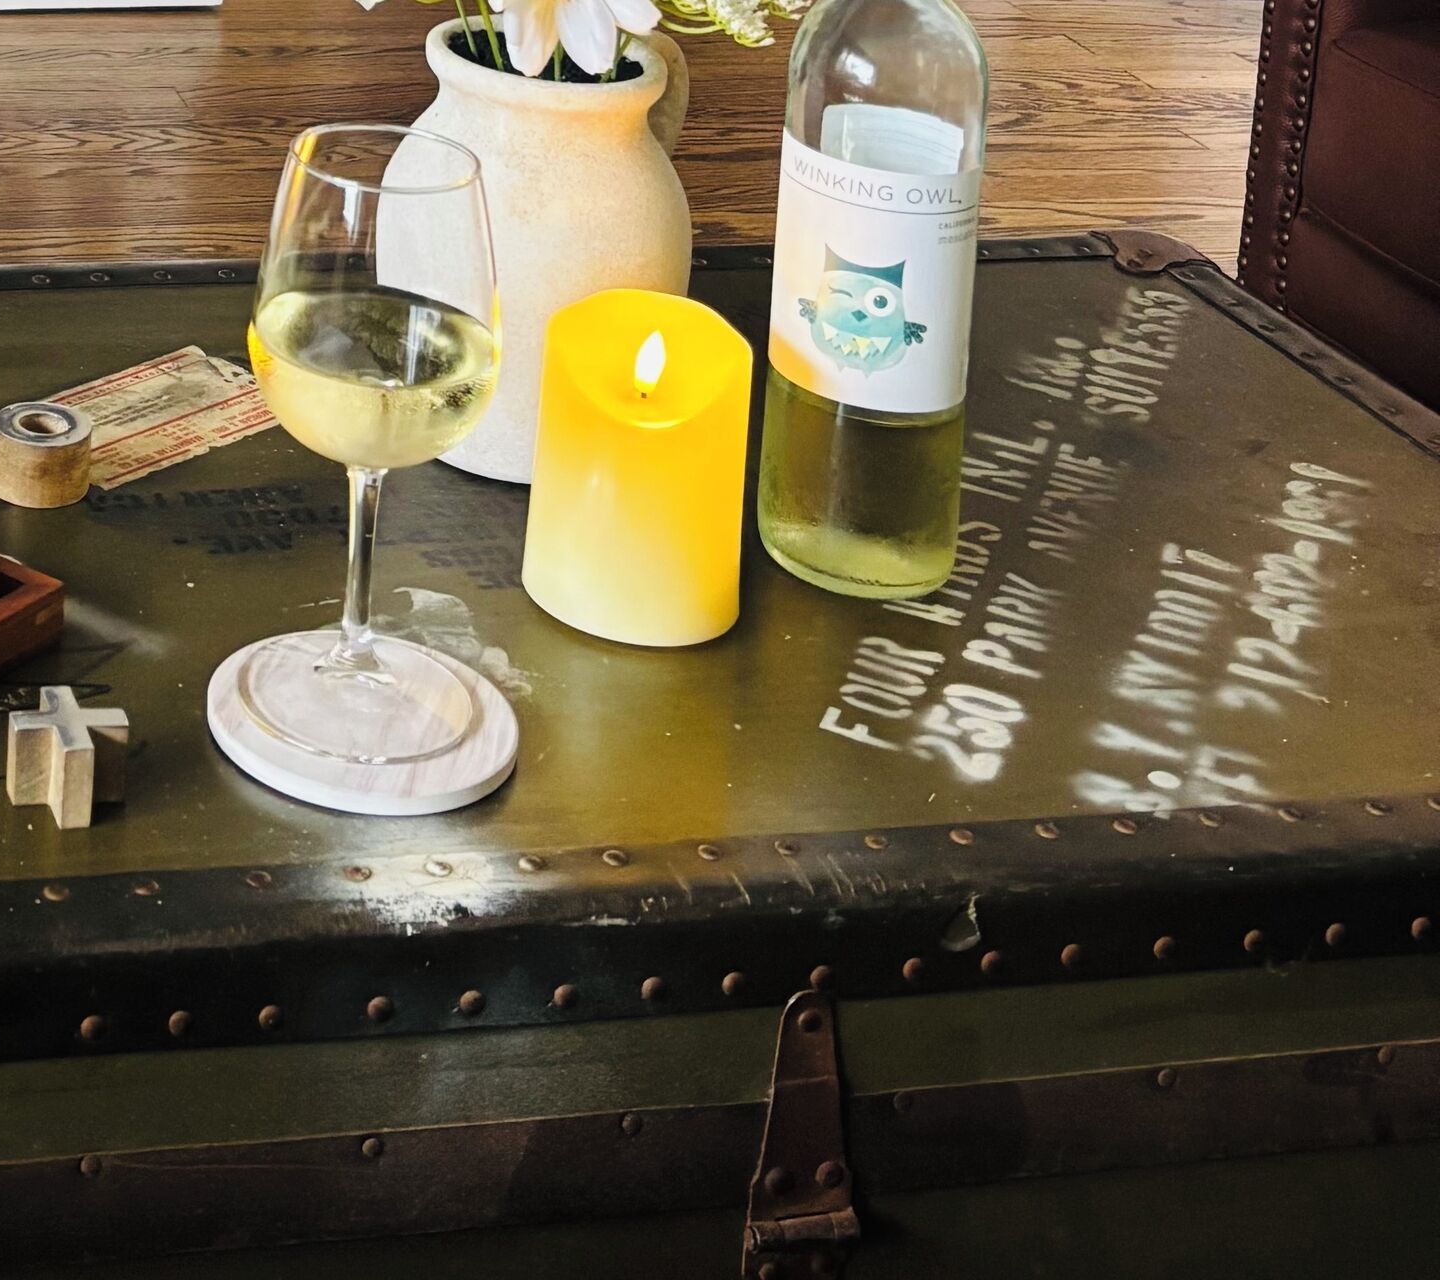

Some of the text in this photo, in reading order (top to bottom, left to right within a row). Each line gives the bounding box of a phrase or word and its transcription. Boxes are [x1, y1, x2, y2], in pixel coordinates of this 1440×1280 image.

[793, 154, 895, 202] WINKING
[961, 571, 1064, 680] PARK
[818, 635, 947, 752] FOUR
[910, 681, 1027, 785] 250
